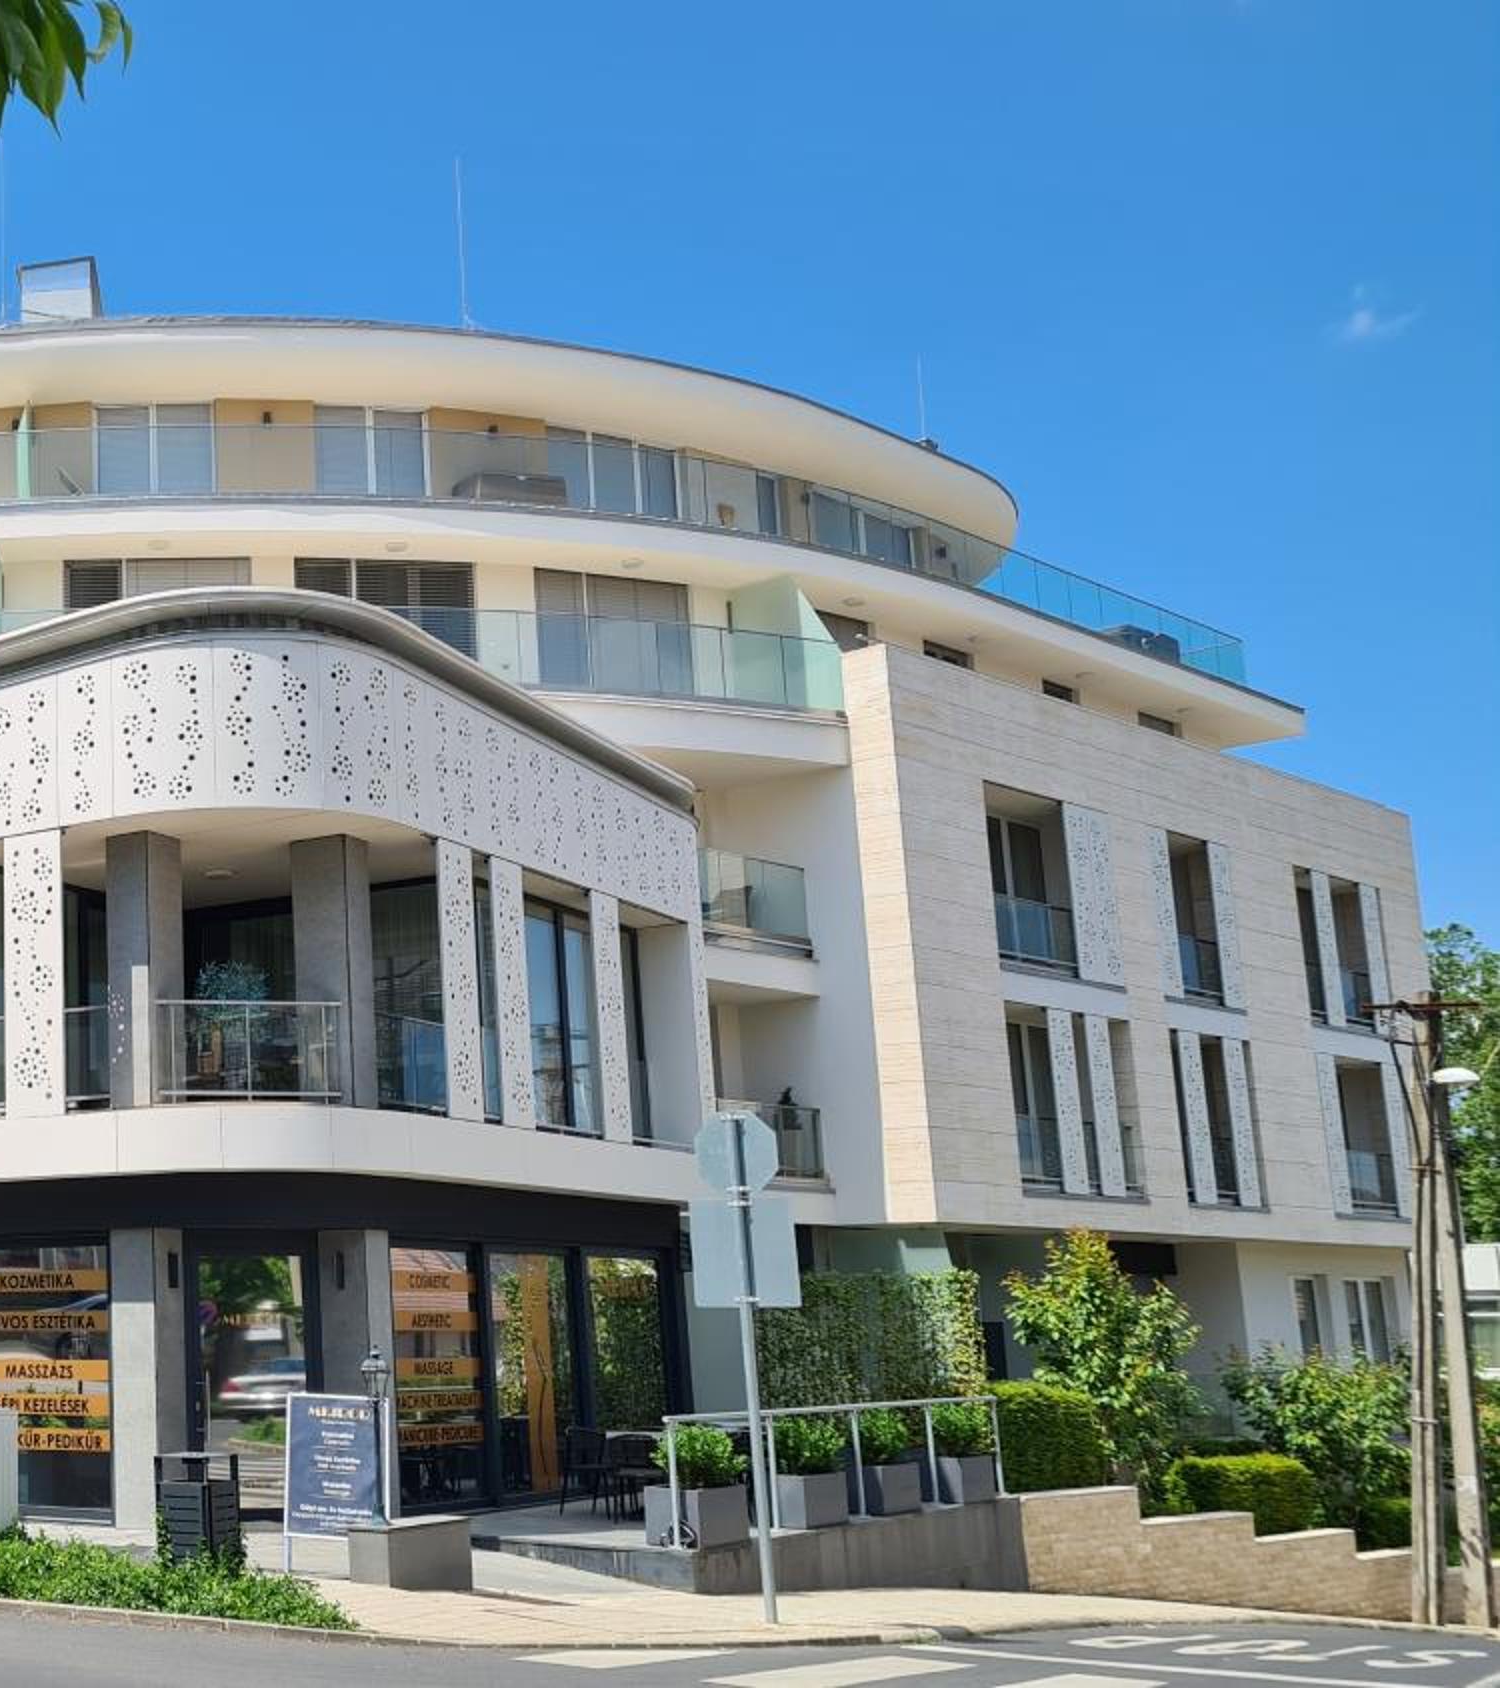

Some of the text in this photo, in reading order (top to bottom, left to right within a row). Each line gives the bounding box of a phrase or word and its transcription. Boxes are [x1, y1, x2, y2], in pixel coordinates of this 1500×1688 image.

[0, 1274, 75, 1289] KOZMETIKA
[33, 1311, 95, 1329] ESZTÉTIKA
[23, 1393, 89, 1413] KEZELÉSEK
